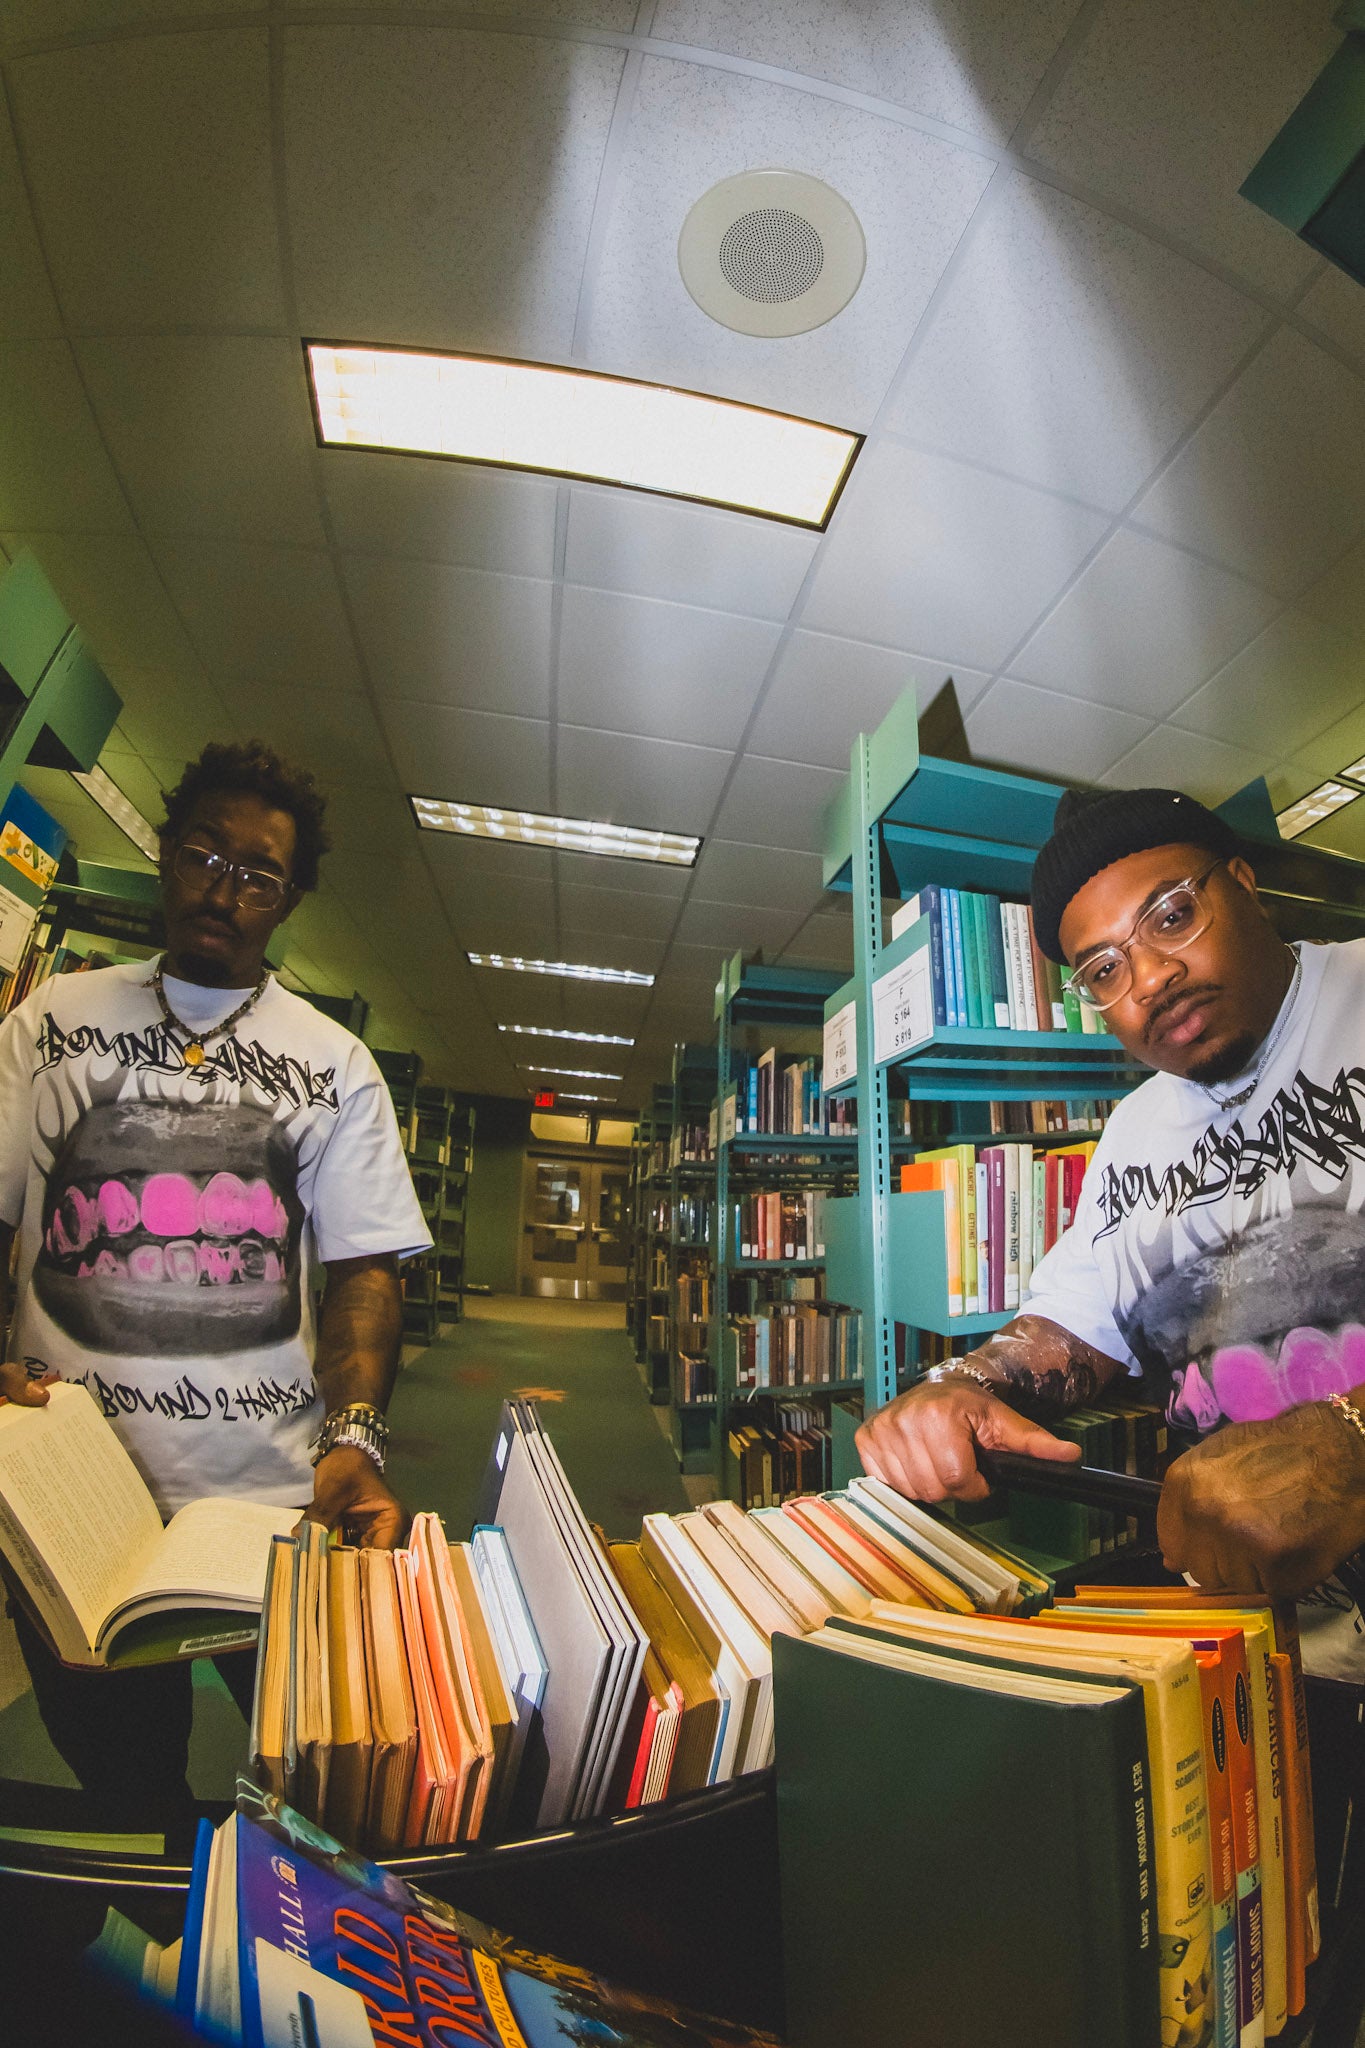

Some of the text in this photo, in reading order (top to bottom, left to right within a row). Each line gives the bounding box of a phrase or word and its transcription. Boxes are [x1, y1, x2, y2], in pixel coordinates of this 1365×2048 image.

[894, 1005, 910, 1025] S 164
[894, 1028, 912, 1047] S 819
[1010, 1191, 1018, 1262] rainbow high
[93, 1370, 212, 1422] BOUND
[215, 1387, 238, 1422] 2
[1132, 1761, 1143, 1793] BEST
[1244, 1788, 1255, 1813] FOG
[1134, 1797, 1147, 1867] STORYBOOK
[1220, 1818, 1231, 1846] FOG
[1246, 1816, 1257, 1860] MOUND
[1139, 1869, 1149, 1900] EVER
[1221, 1848, 1232, 1892] MOUND
[279, 1891, 312, 1966] HALL
[1249, 1902, 1262, 1968] SIMON'S
[334, 1908, 425, 2048] RLD
[480, 1961, 515, 2033] CULTURES
